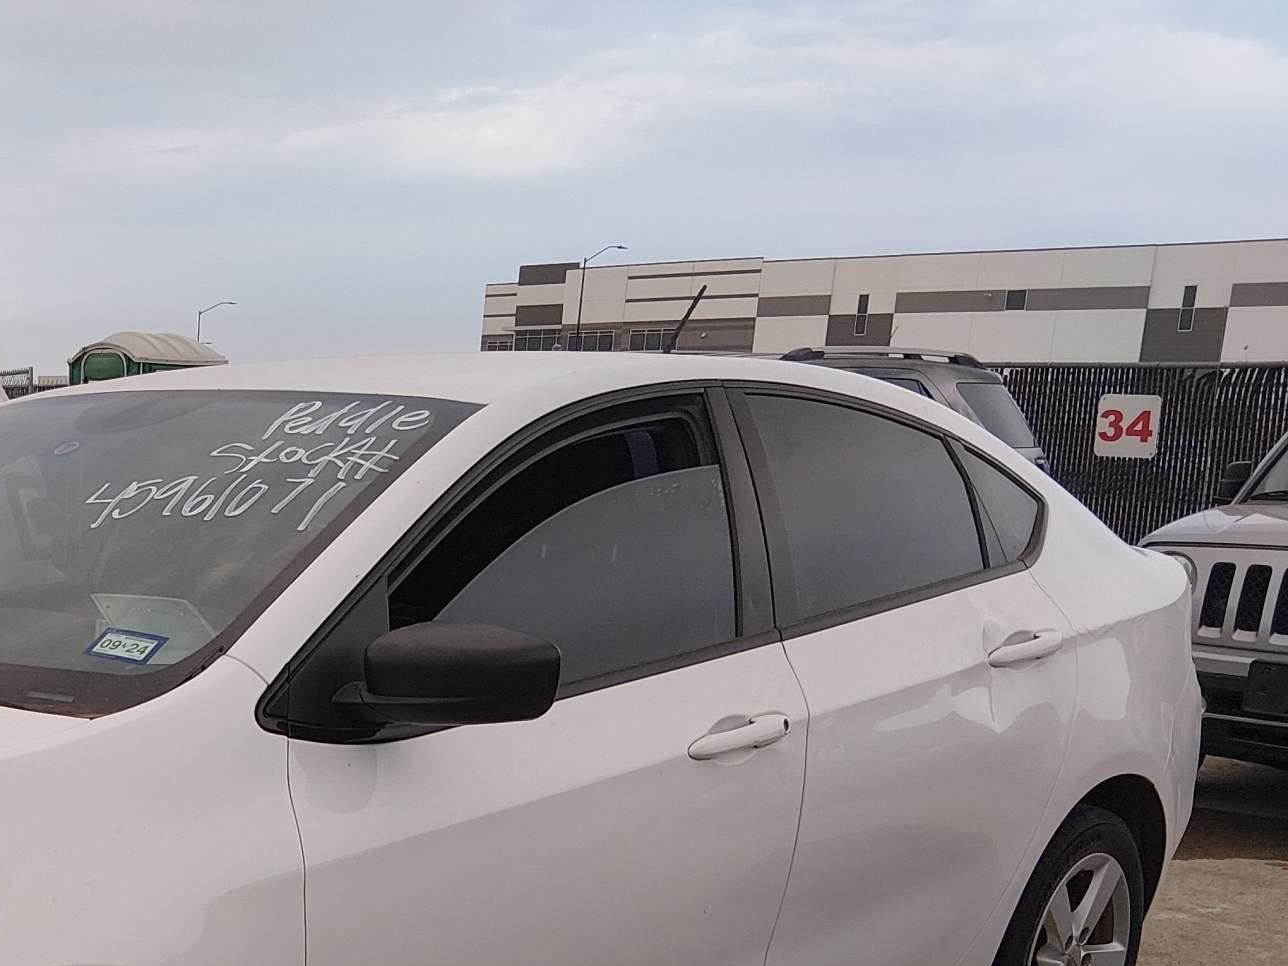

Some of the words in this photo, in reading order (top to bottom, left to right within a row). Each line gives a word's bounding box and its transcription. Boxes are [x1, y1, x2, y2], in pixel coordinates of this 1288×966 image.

[262, 400, 431, 440] Peddle
[1098, 409, 1153, 443] 34
[85, 474, 347, 531] 45961071
[99, 638, 123, 650] 09
[125, 643, 149, 656] 24
